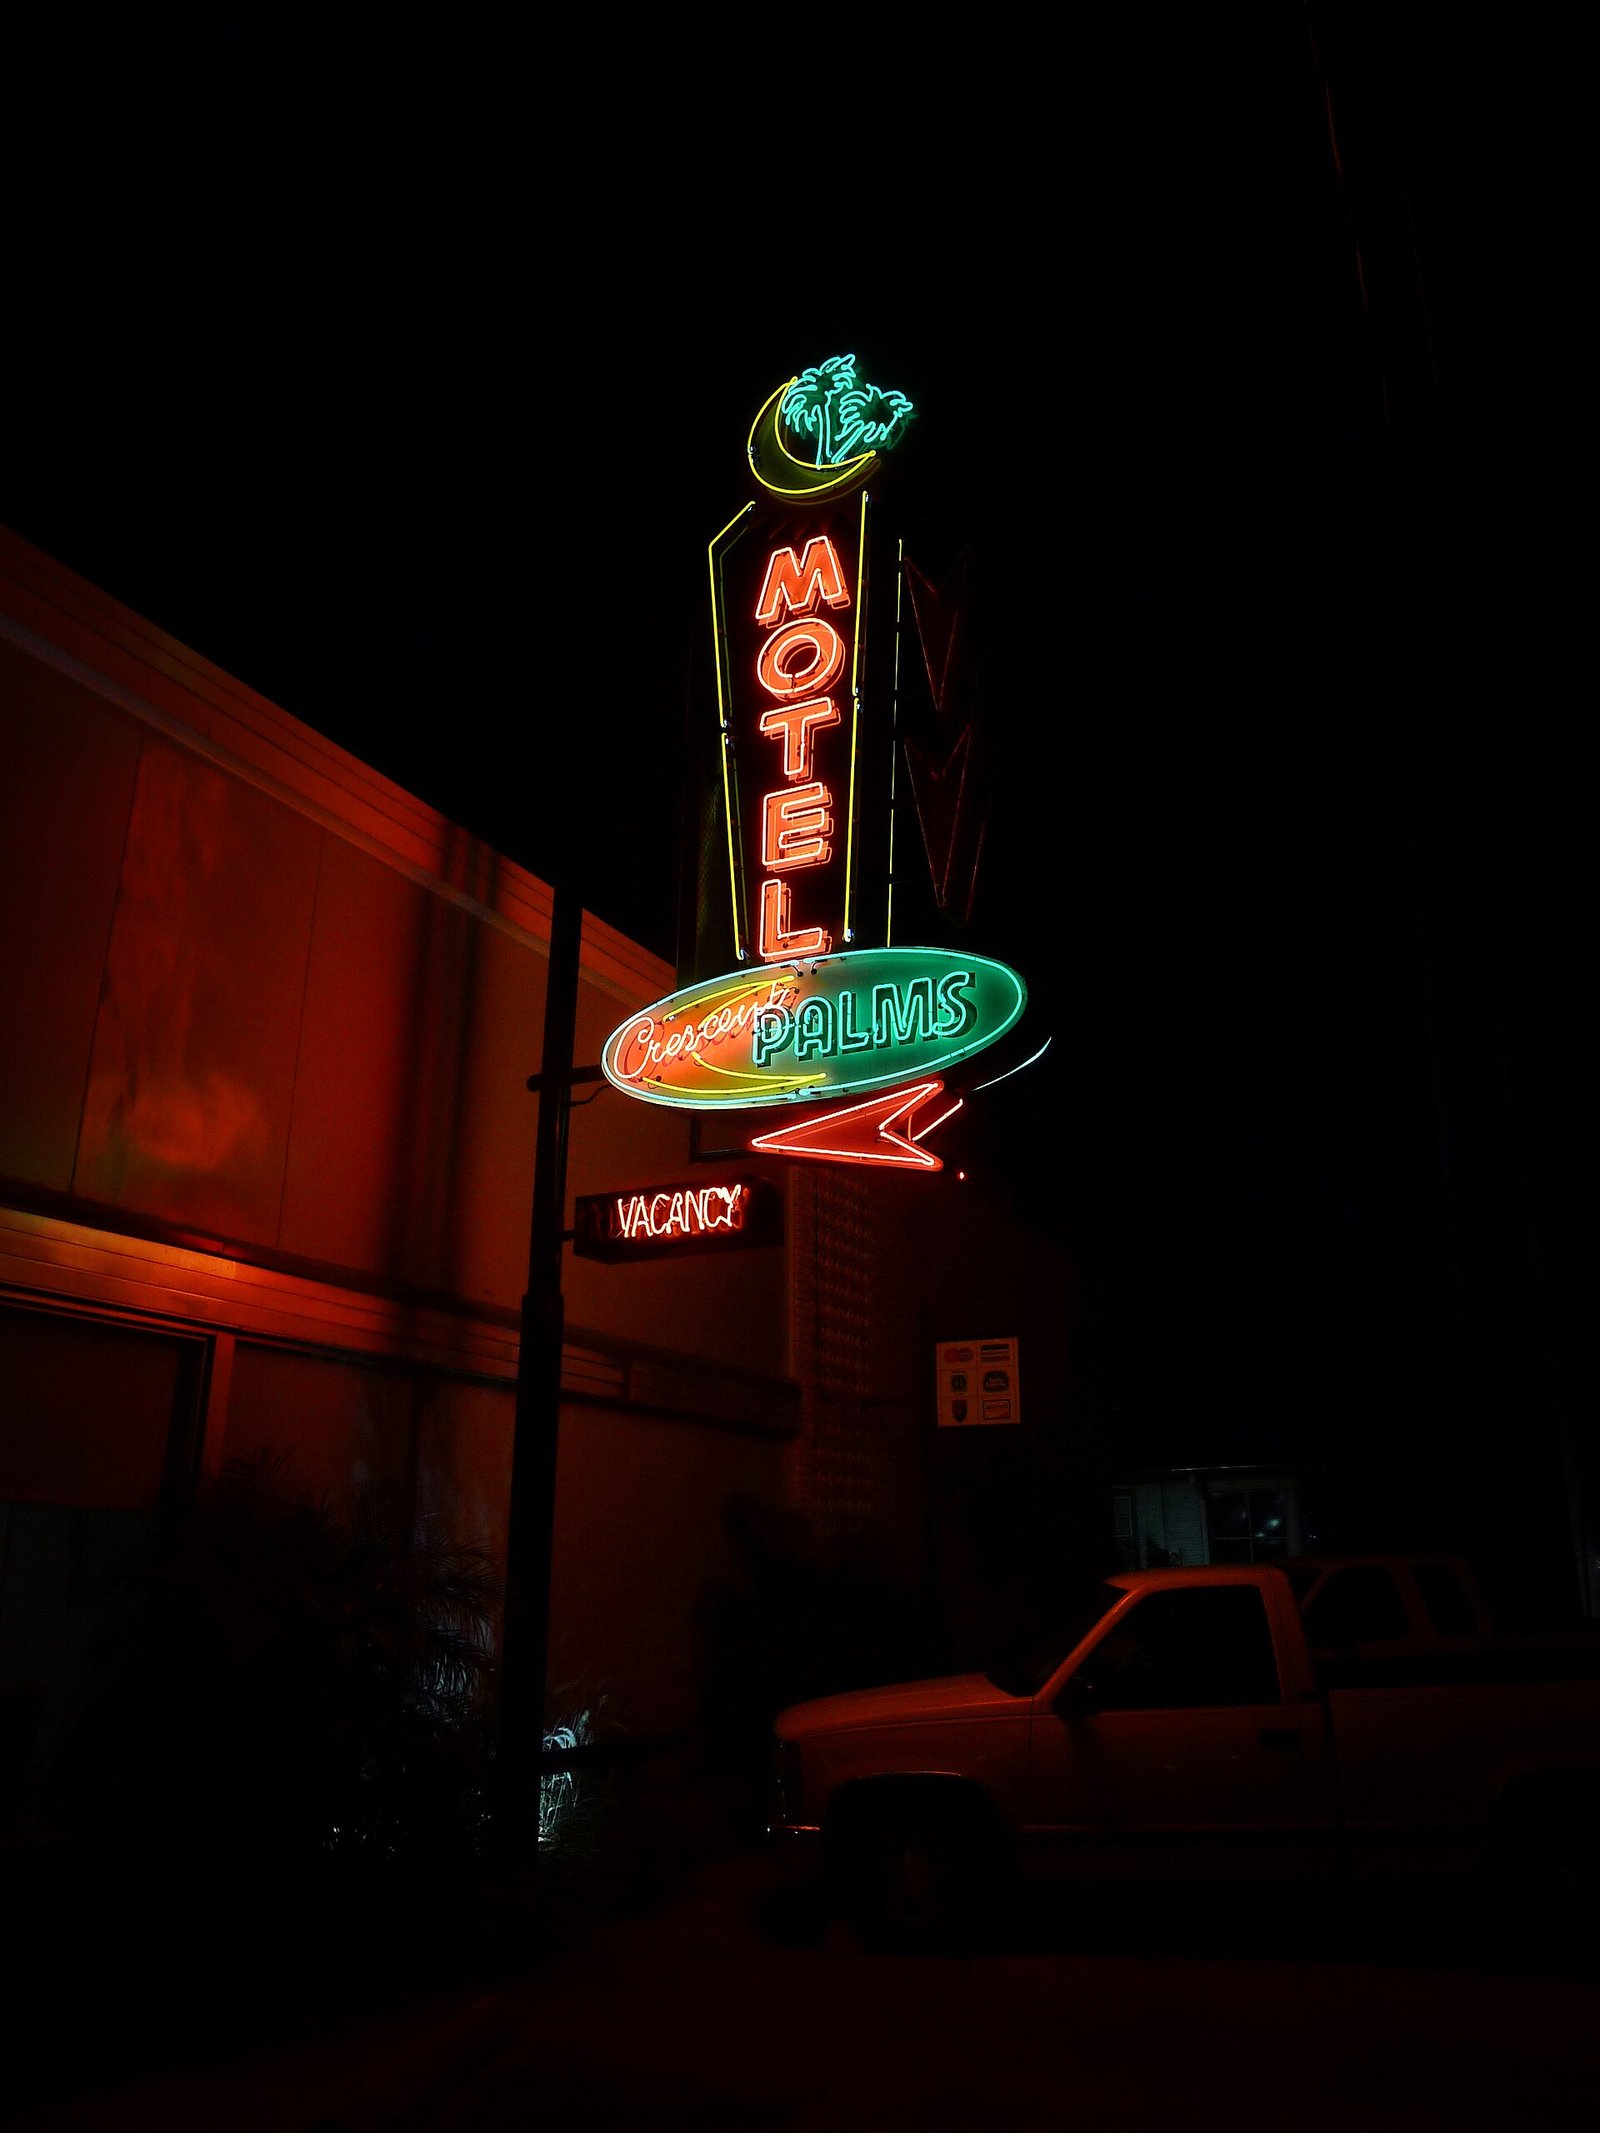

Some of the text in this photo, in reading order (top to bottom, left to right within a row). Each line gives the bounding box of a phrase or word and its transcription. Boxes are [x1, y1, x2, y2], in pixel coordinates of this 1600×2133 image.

[756, 535, 850, 961] MOTEL
[614, 972, 977, 1079] Crescent PALMS
[617, 1184, 742, 1238] VACANCY
